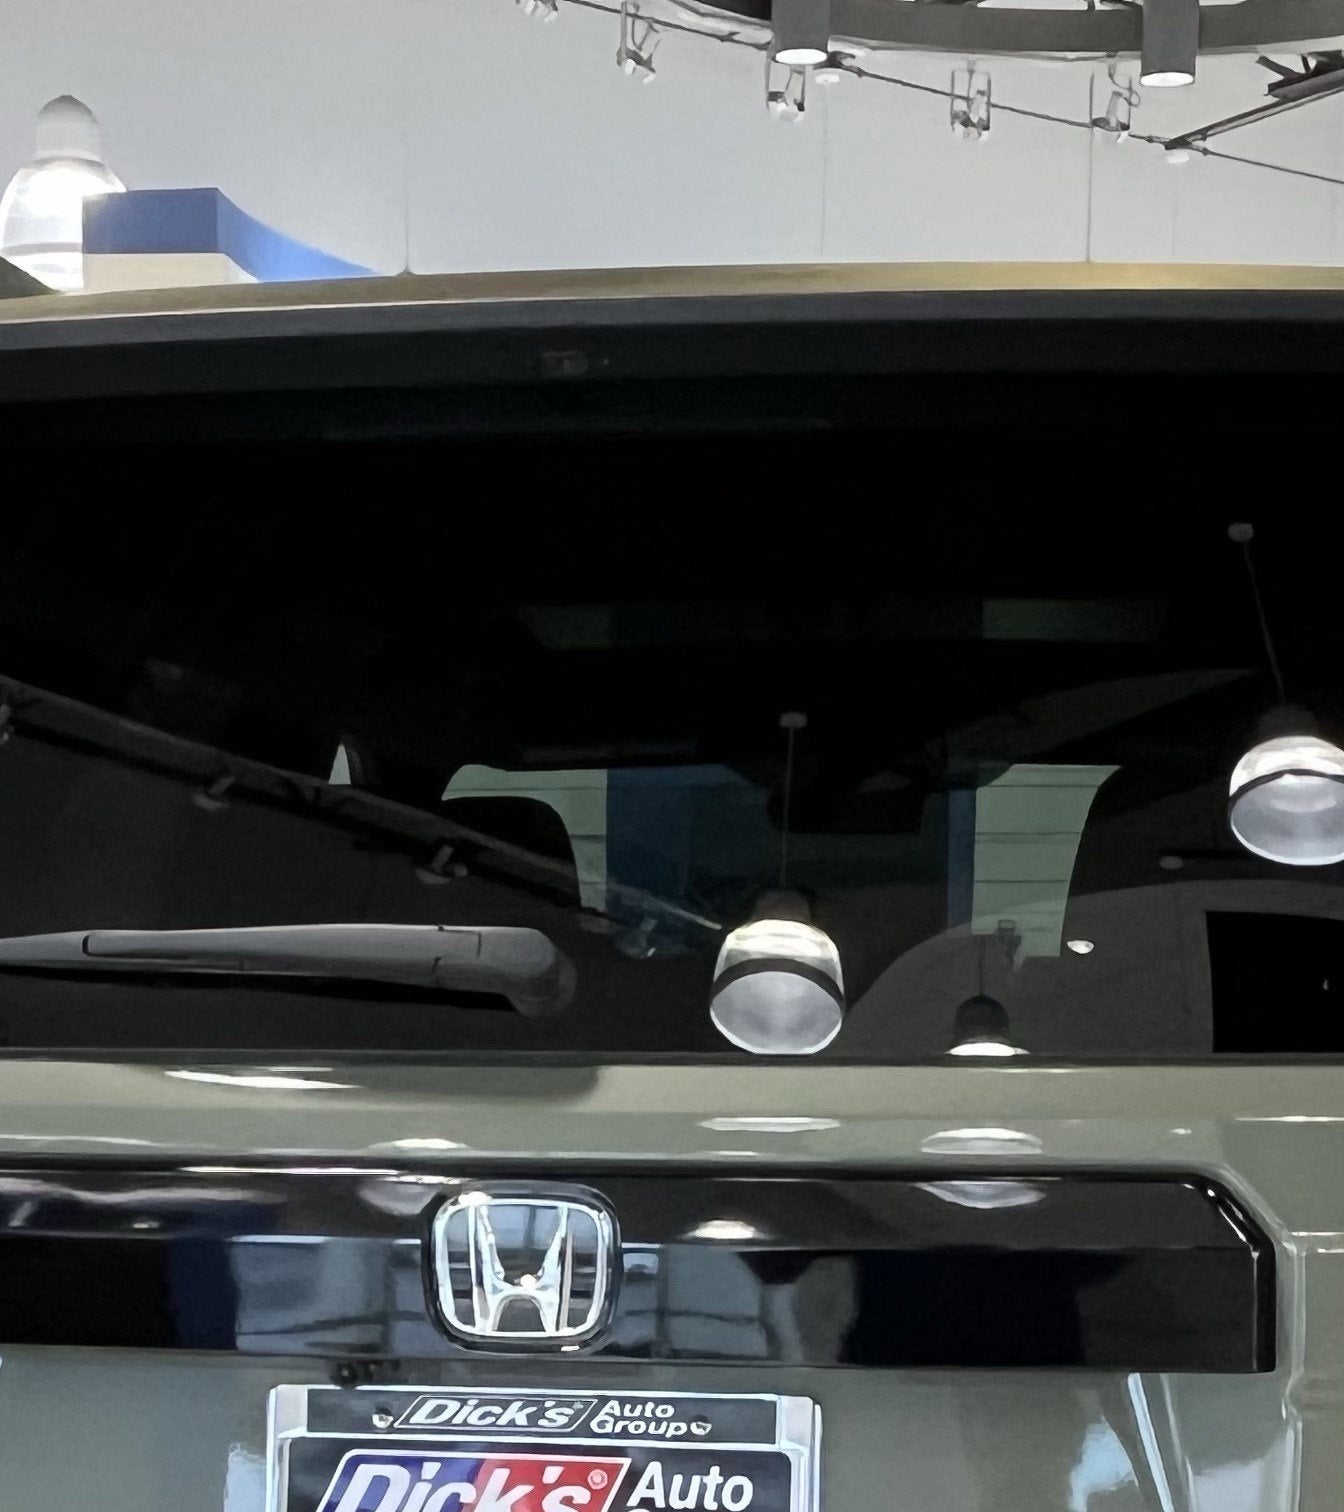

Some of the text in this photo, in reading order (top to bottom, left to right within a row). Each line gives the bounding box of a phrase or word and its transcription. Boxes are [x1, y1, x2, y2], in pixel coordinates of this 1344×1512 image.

[408, 1398, 676, 1428] Dick's Auto
[588, 1416, 688, 1438] Group
[626, 1461, 754, 1512] Auto
